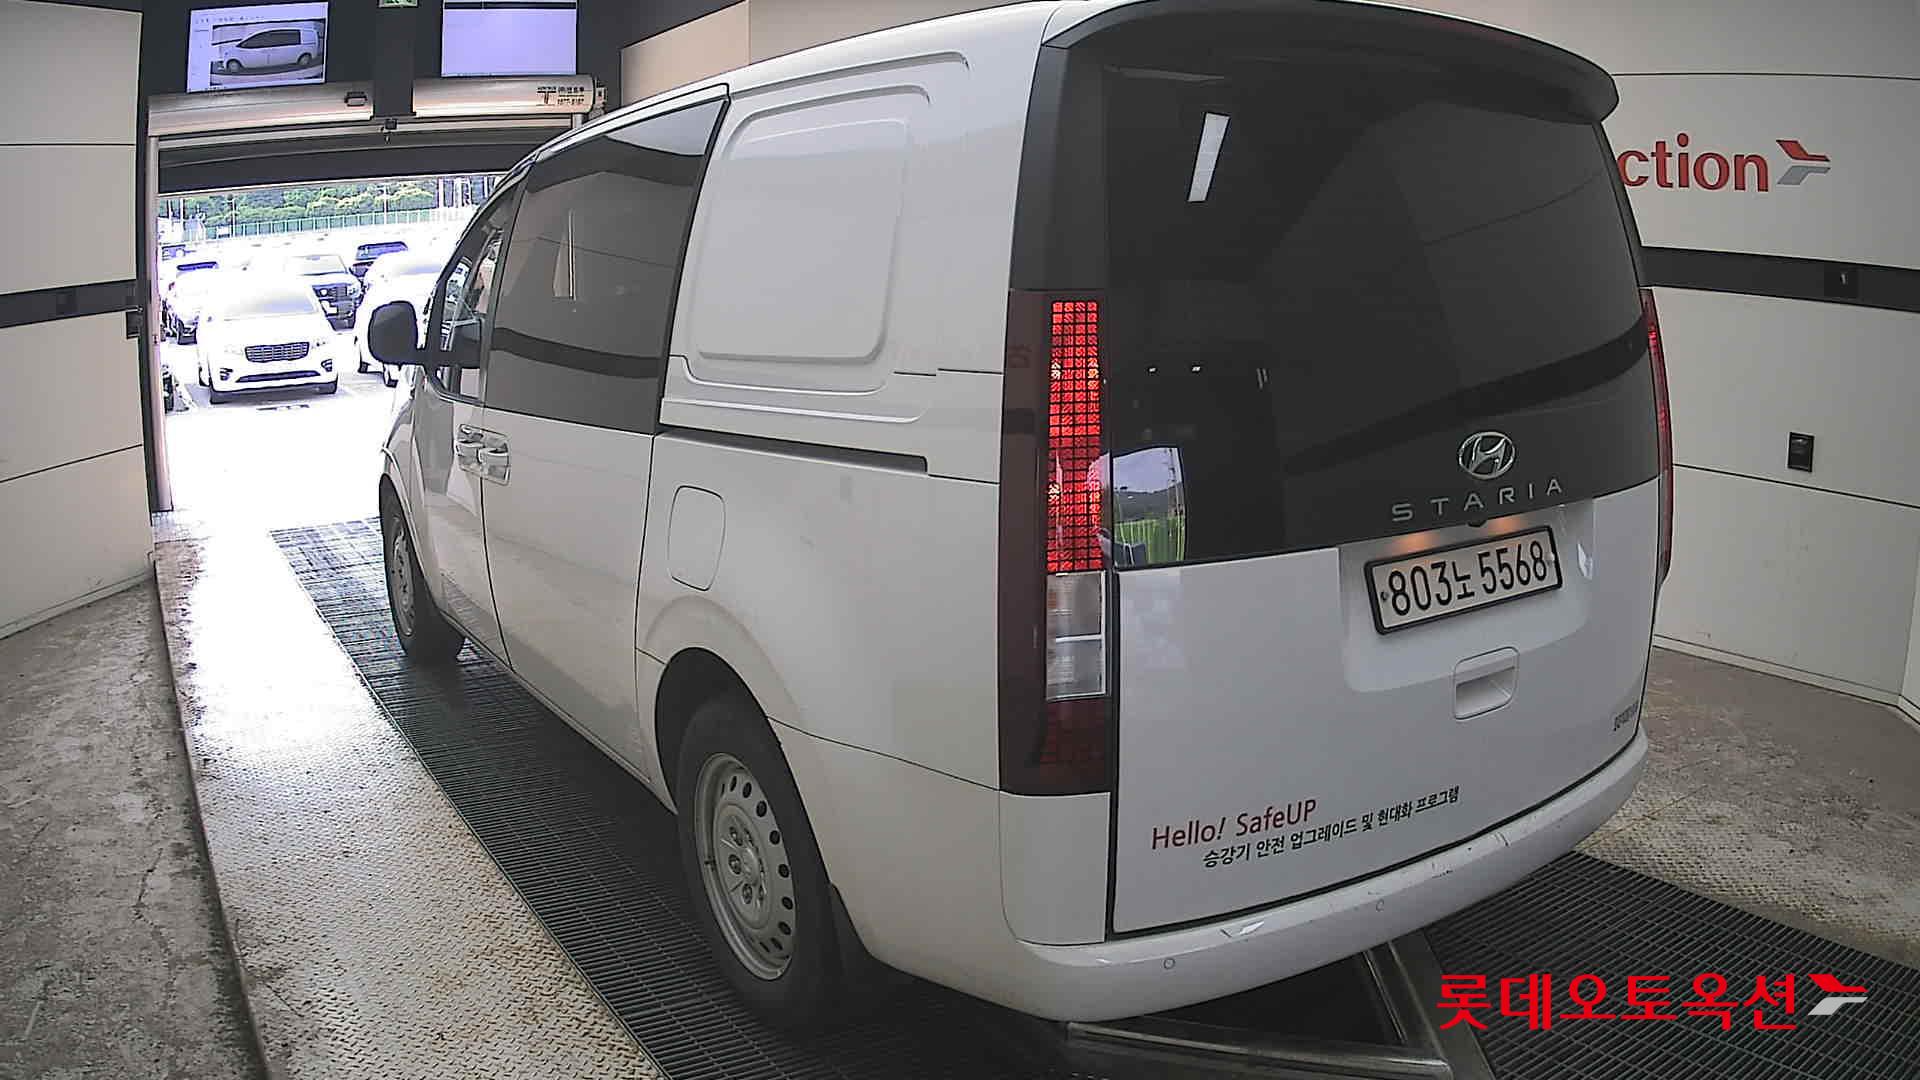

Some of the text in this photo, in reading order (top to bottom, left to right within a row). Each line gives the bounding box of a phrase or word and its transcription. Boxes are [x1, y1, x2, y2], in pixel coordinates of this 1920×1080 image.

[1391, 478, 1563, 523] STARIA
[1387, 540, 1548, 616] 803노 5568
[1151, 799, 1317, 850] Hello! SafeUP
[1202, 785, 1460, 868] 승강기 안전 업그레이드 및 현대화 프로그램
